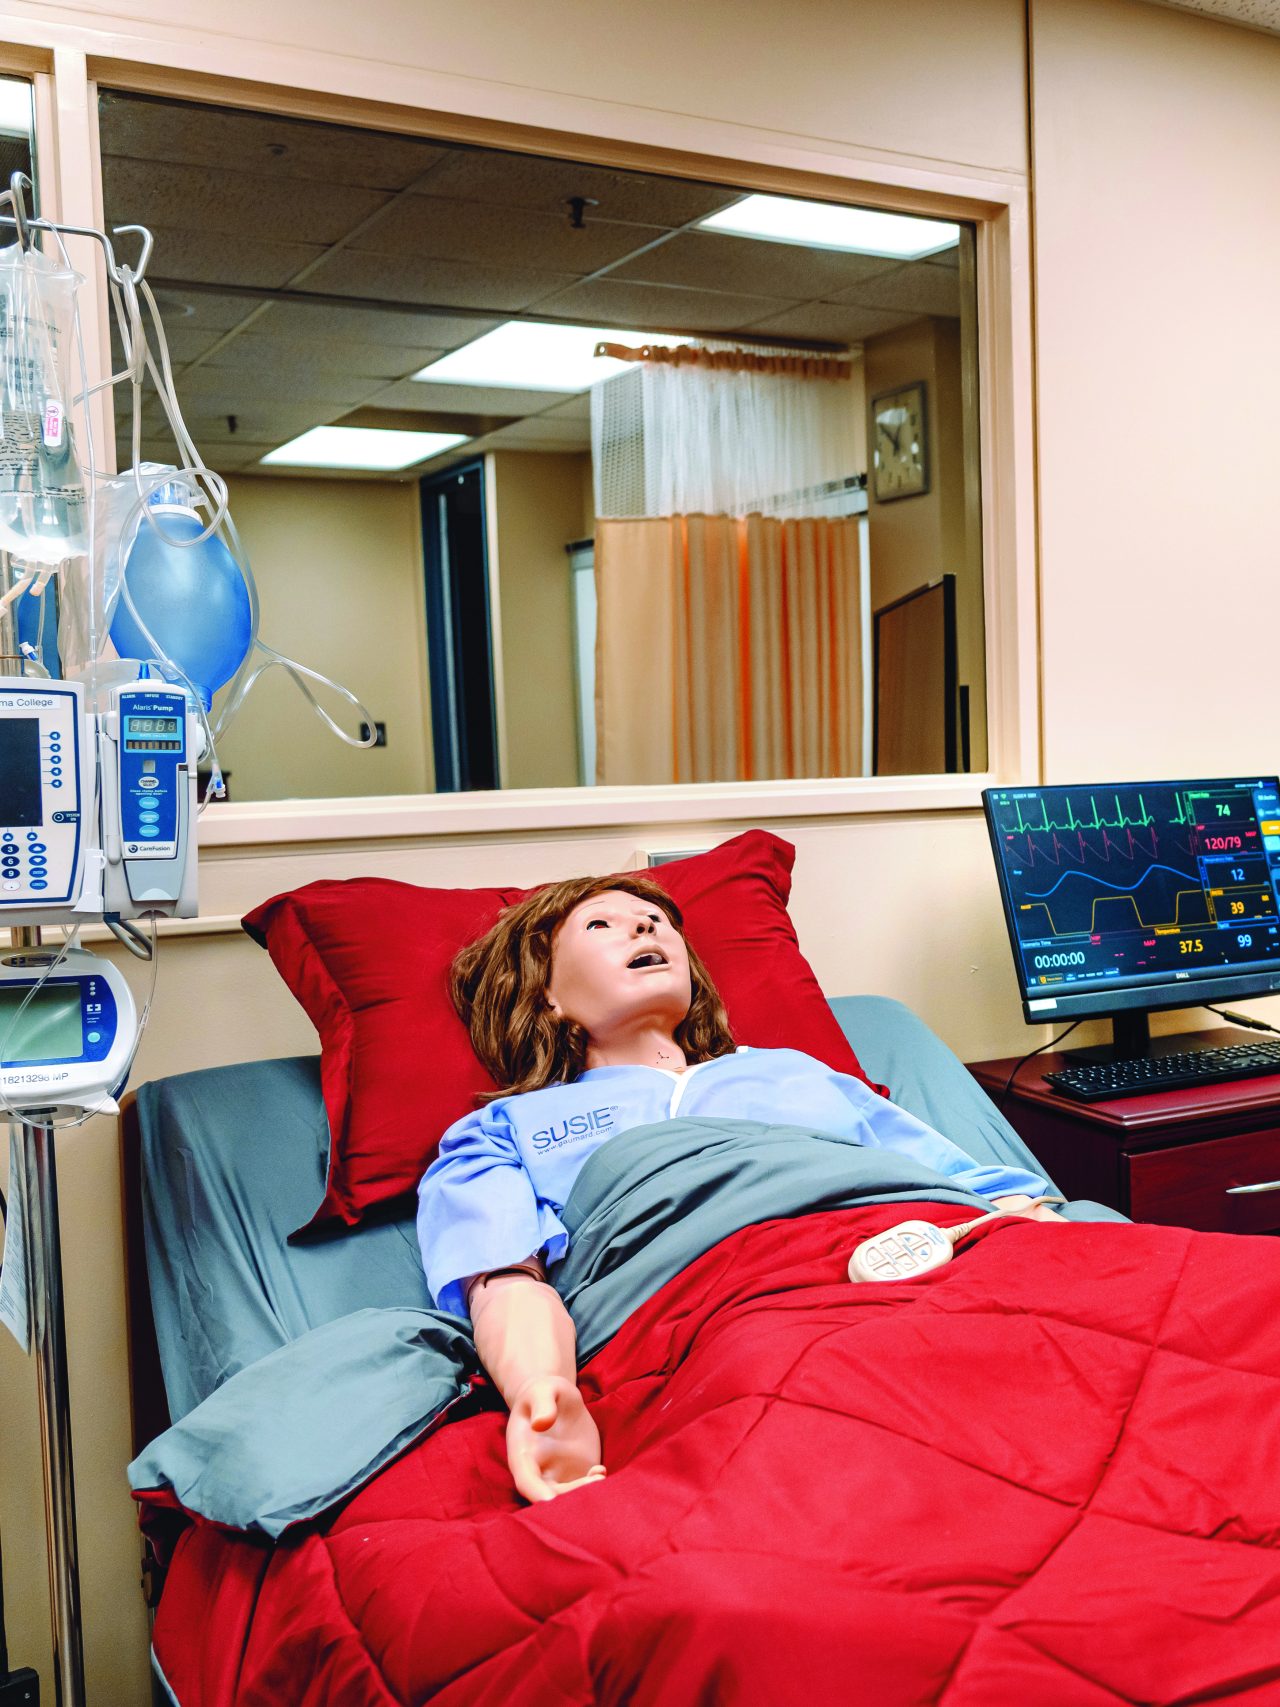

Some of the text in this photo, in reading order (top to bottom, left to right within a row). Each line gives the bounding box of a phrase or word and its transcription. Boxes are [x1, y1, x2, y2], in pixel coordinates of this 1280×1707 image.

[17, 699, 53, 707] College
[1216, 804, 1231, 816] 74
[1205, 836, 1241, 850] 120/79
[1230, 868, 1245, 881] 12
[1230, 901, 1245, 914] 39
[1179, 939, 1204, 954] 37.5
[1237, 934, 1252, 948] 99
[1035, 952, 1085, 969] 00:00:00
[537, 1126, 612, 1156] www.gaumard.com
